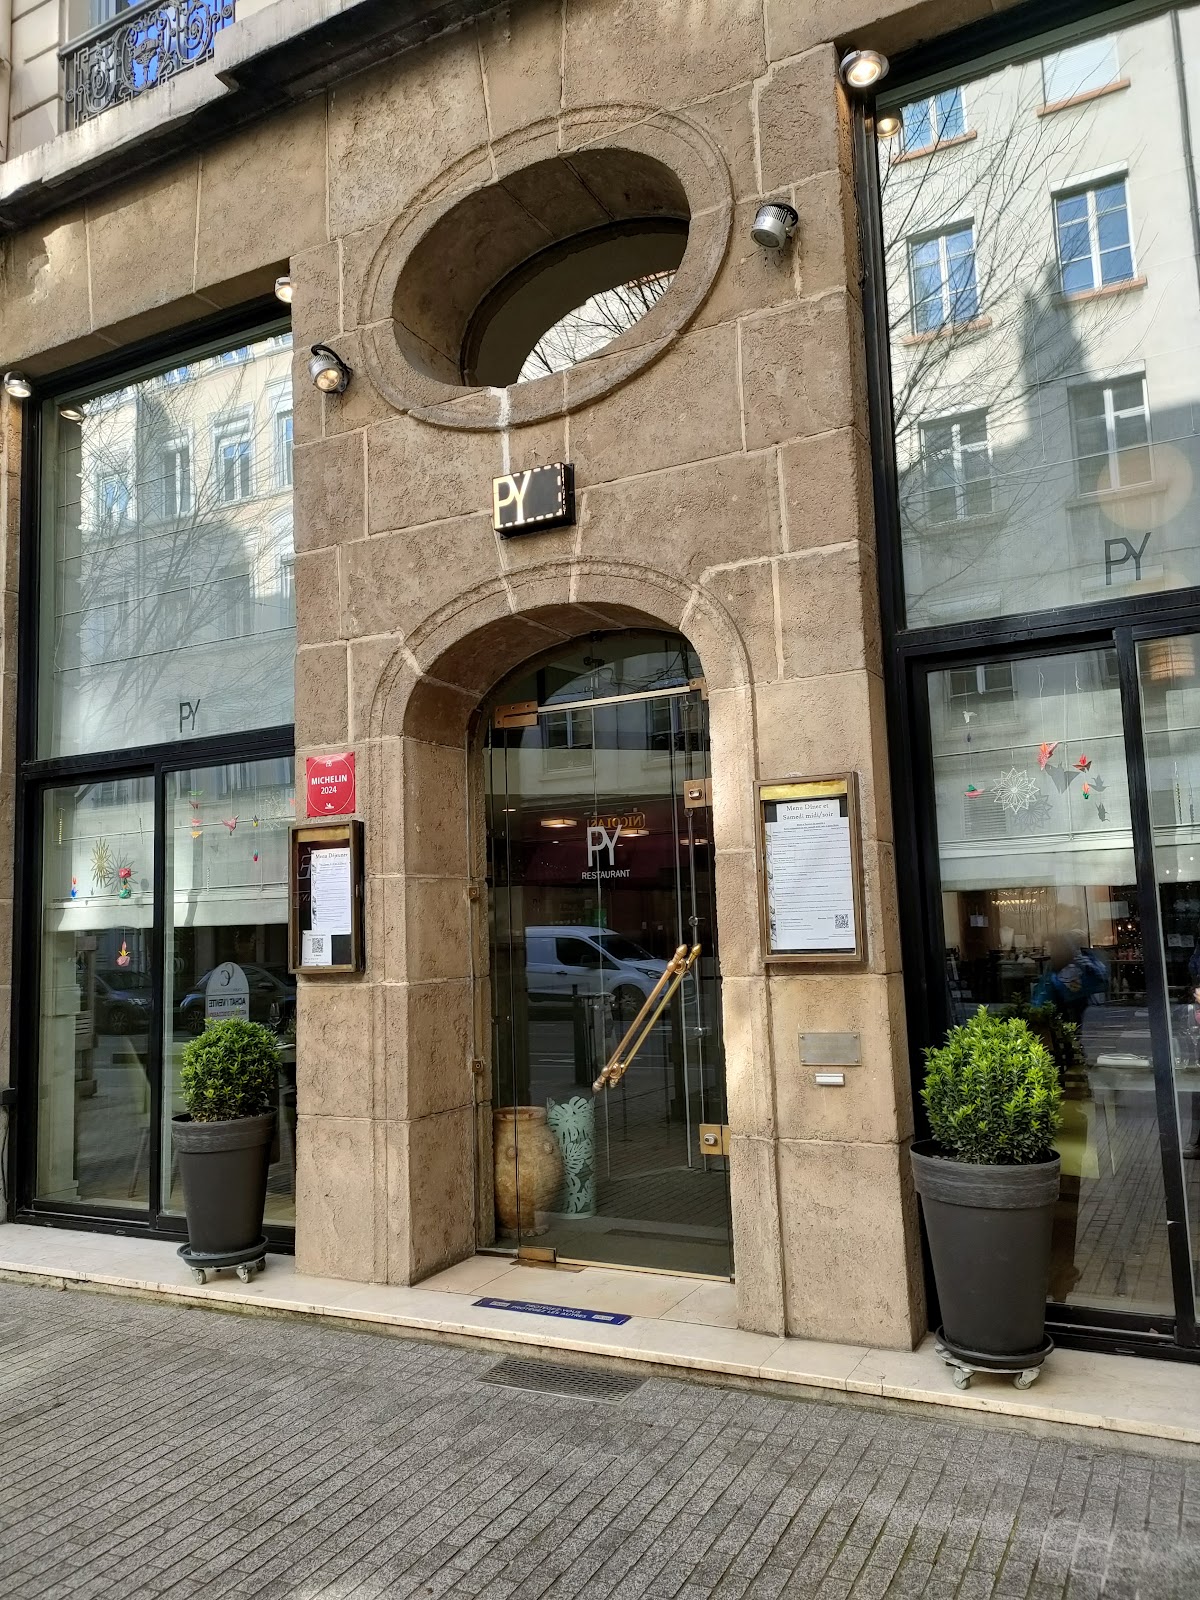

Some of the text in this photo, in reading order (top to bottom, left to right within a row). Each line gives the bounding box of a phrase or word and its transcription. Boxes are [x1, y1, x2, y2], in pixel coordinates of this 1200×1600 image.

[493, 470, 532, 529] PY
[1104, 531, 1152, 586] PY
[179, 698, 201, 733] PY
[311, 774, 348, 785] MICHELIN
[320, 785, 337, 795] 2024
[586, 824, 622, 867] PY
[581, 869, 630, 880] RESTAURANT
